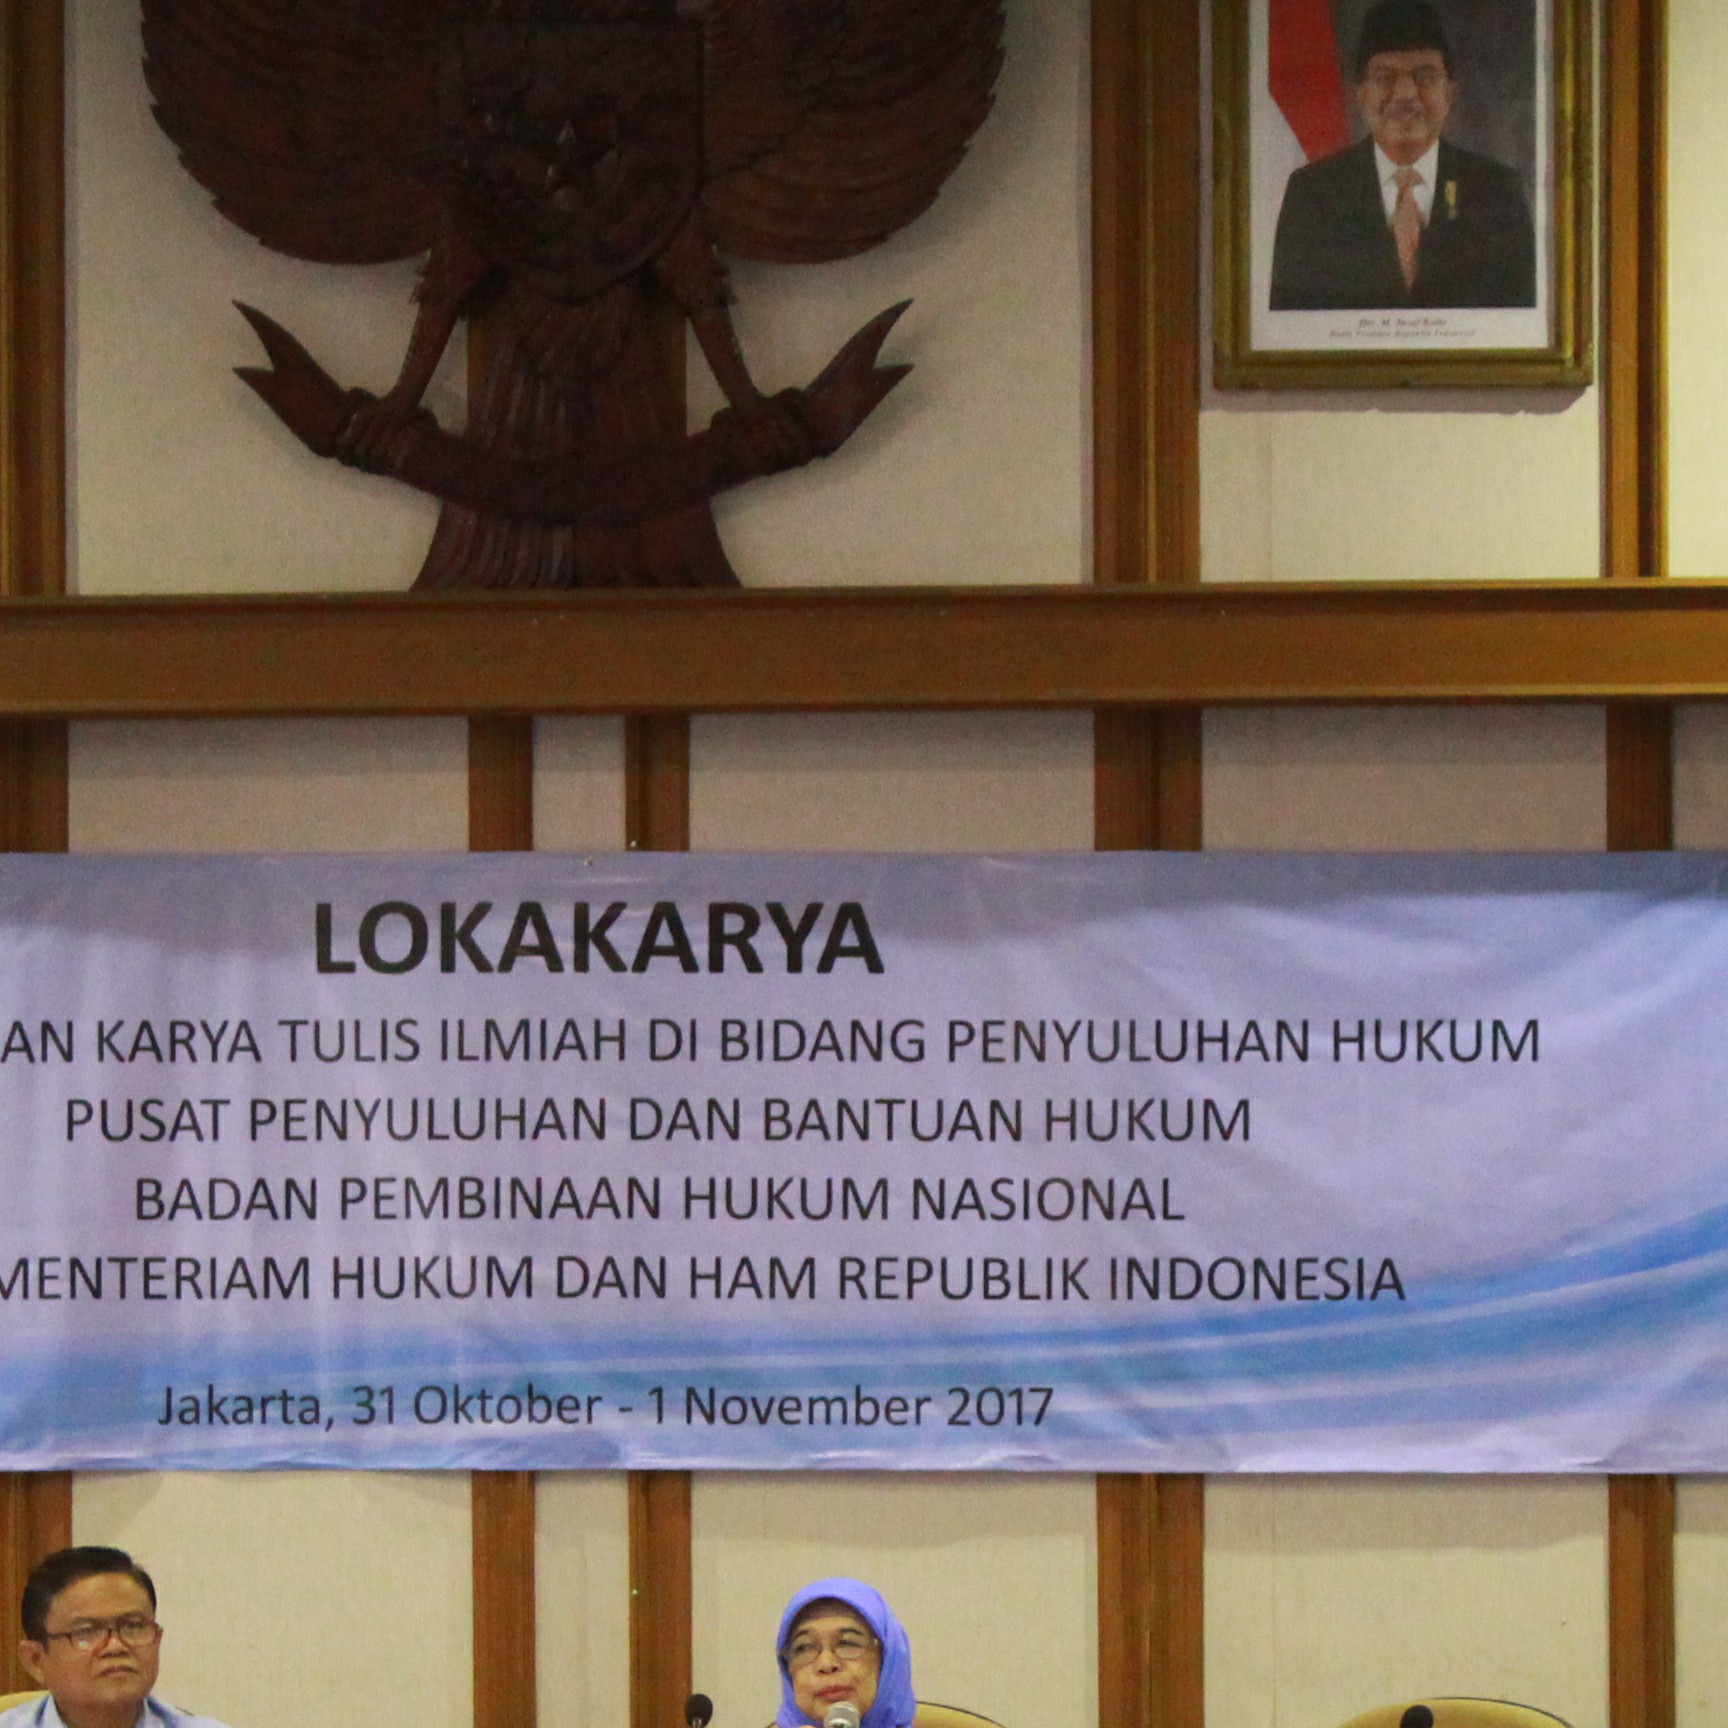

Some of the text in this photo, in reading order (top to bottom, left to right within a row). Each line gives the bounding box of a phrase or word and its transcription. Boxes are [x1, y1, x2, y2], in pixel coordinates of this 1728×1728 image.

[316, 901, 885, 975] LOKAKARYA
[97, 1020, 262, 1065] KARYA
[278, 1018, 420, 1064] TULIS
[441, 1018, 626, 1063] ILMIAH
[649, 1018, 697, 1063] DI
[721, 1018, 925, 1064] BIDANG
[948, 1018, 1309, 1064] PENYULUHAN
[1333, 1018, 1539, 1064] HUKUM
[67, 1097, 1250, 1143] PUSAT PENYULUHAN DAN BANTUAN HUKUM
[136, 1176, 1185, 1222] BADAN PEMBINAAN HUKUM NASIONAL
[333, 1255, 533, 1300] HUKUM
[556, 1255, 666, 1300] DAN
[690, 1255, 815, 1300] HAM
[839, 1256, 1089, 1301] REPUBLIK
[1110, 1256, 1406, 1302] INDONESIA
[158, 1383, 334, 1432] Jakarta,
[352, 1385, 395, 1426] 31
[413, 1381, 603, 1425] Oktober
[648, 1385, 665, 1424] 1
[685, 1383, 932, 1426] November
[948, 1386, 1054, 1426] 2017
